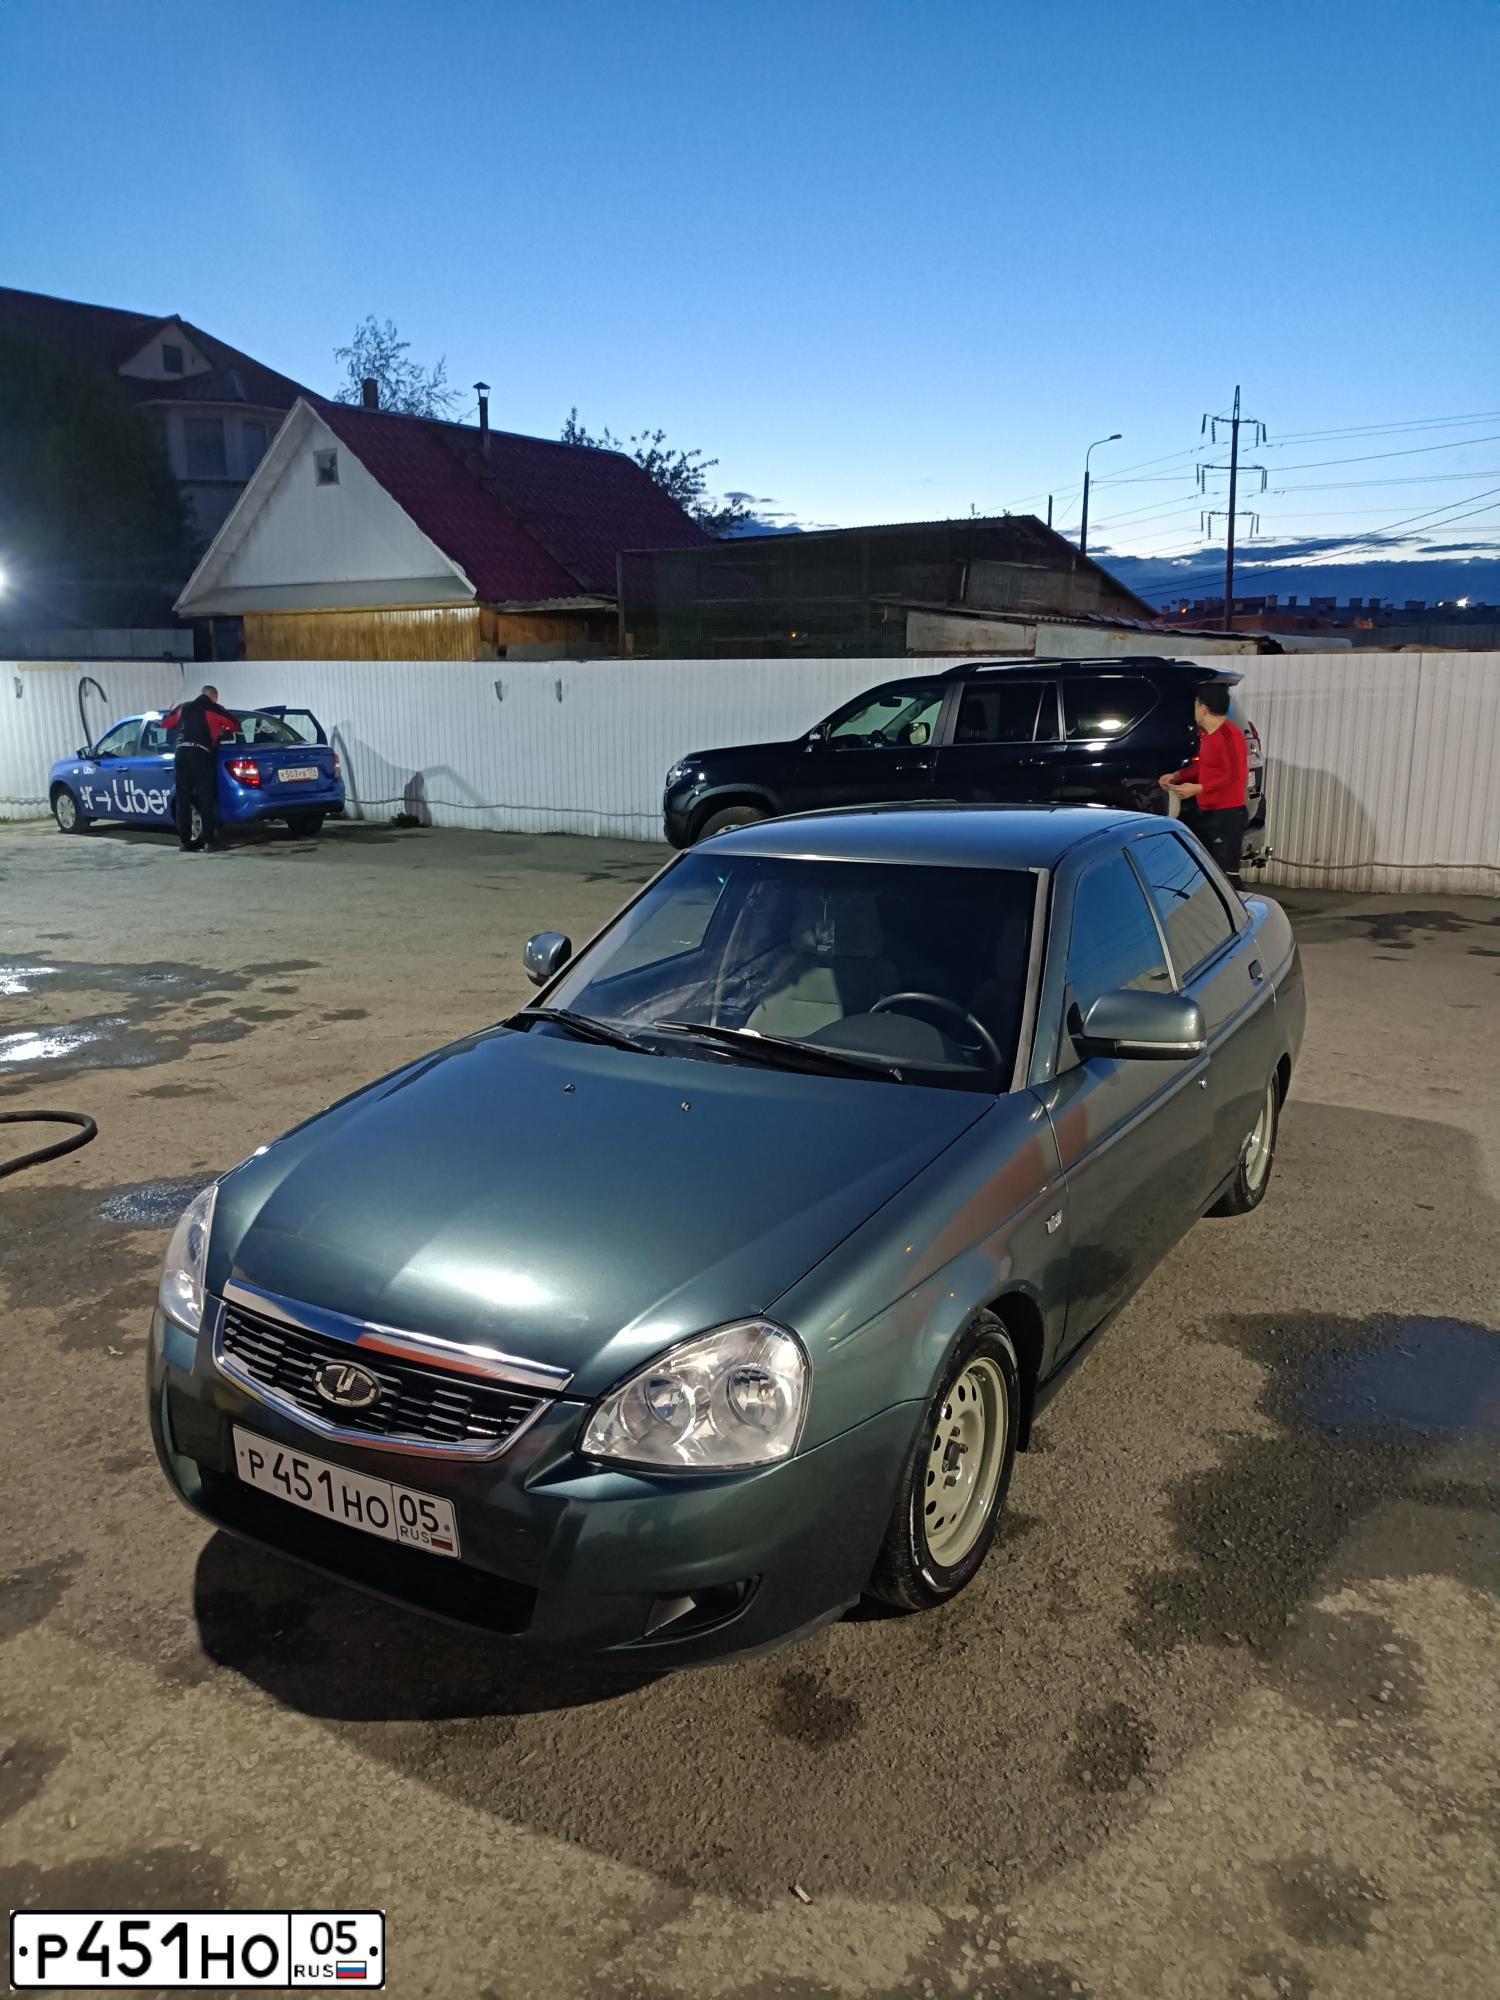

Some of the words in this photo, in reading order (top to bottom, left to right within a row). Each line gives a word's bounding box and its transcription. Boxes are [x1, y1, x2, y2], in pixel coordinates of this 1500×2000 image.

[112, 779, 171, 815] Uber
[399, 1494, 439, 1532] 05
[399, 1524, 430, 1544] RUS
